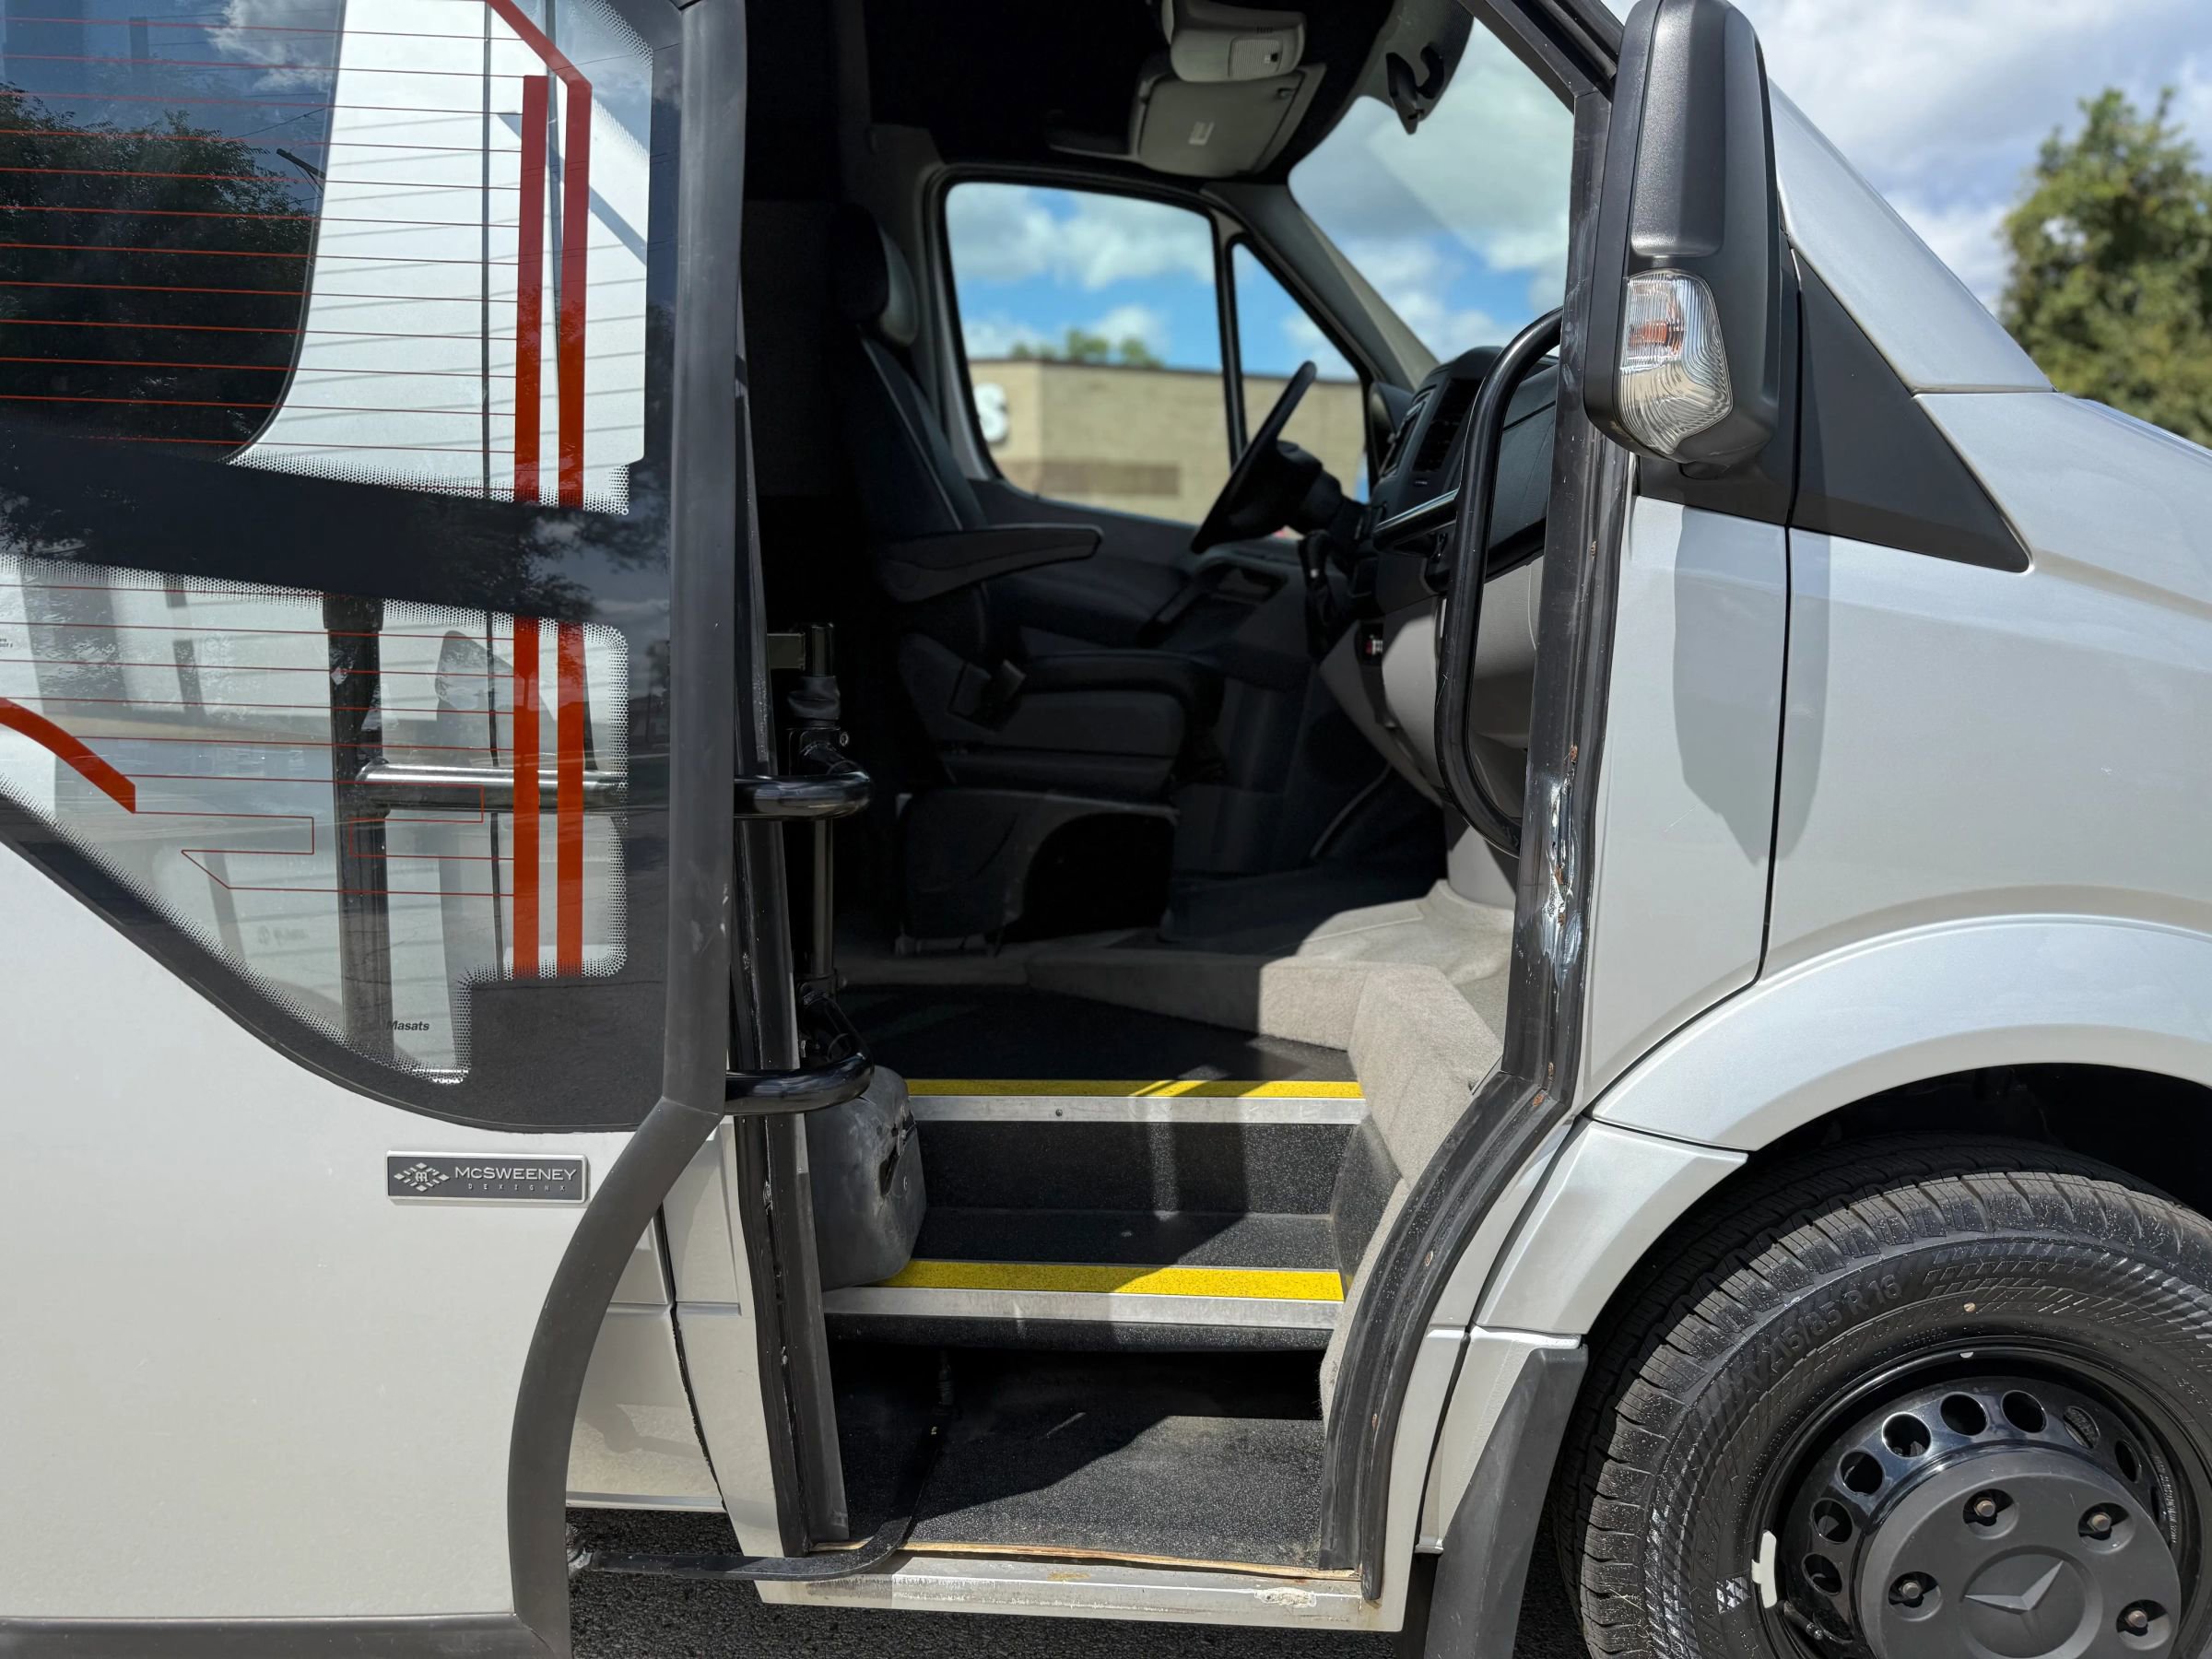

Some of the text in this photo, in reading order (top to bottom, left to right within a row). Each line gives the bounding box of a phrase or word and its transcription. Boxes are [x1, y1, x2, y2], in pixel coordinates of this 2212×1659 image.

[386, 1020, 430, 1031] Masats
[1761, 1300, 1842, 1374] 215/85
[1843, 1288, 1870, 1316] R
[1867, 1274, 1903, 1304] 16
